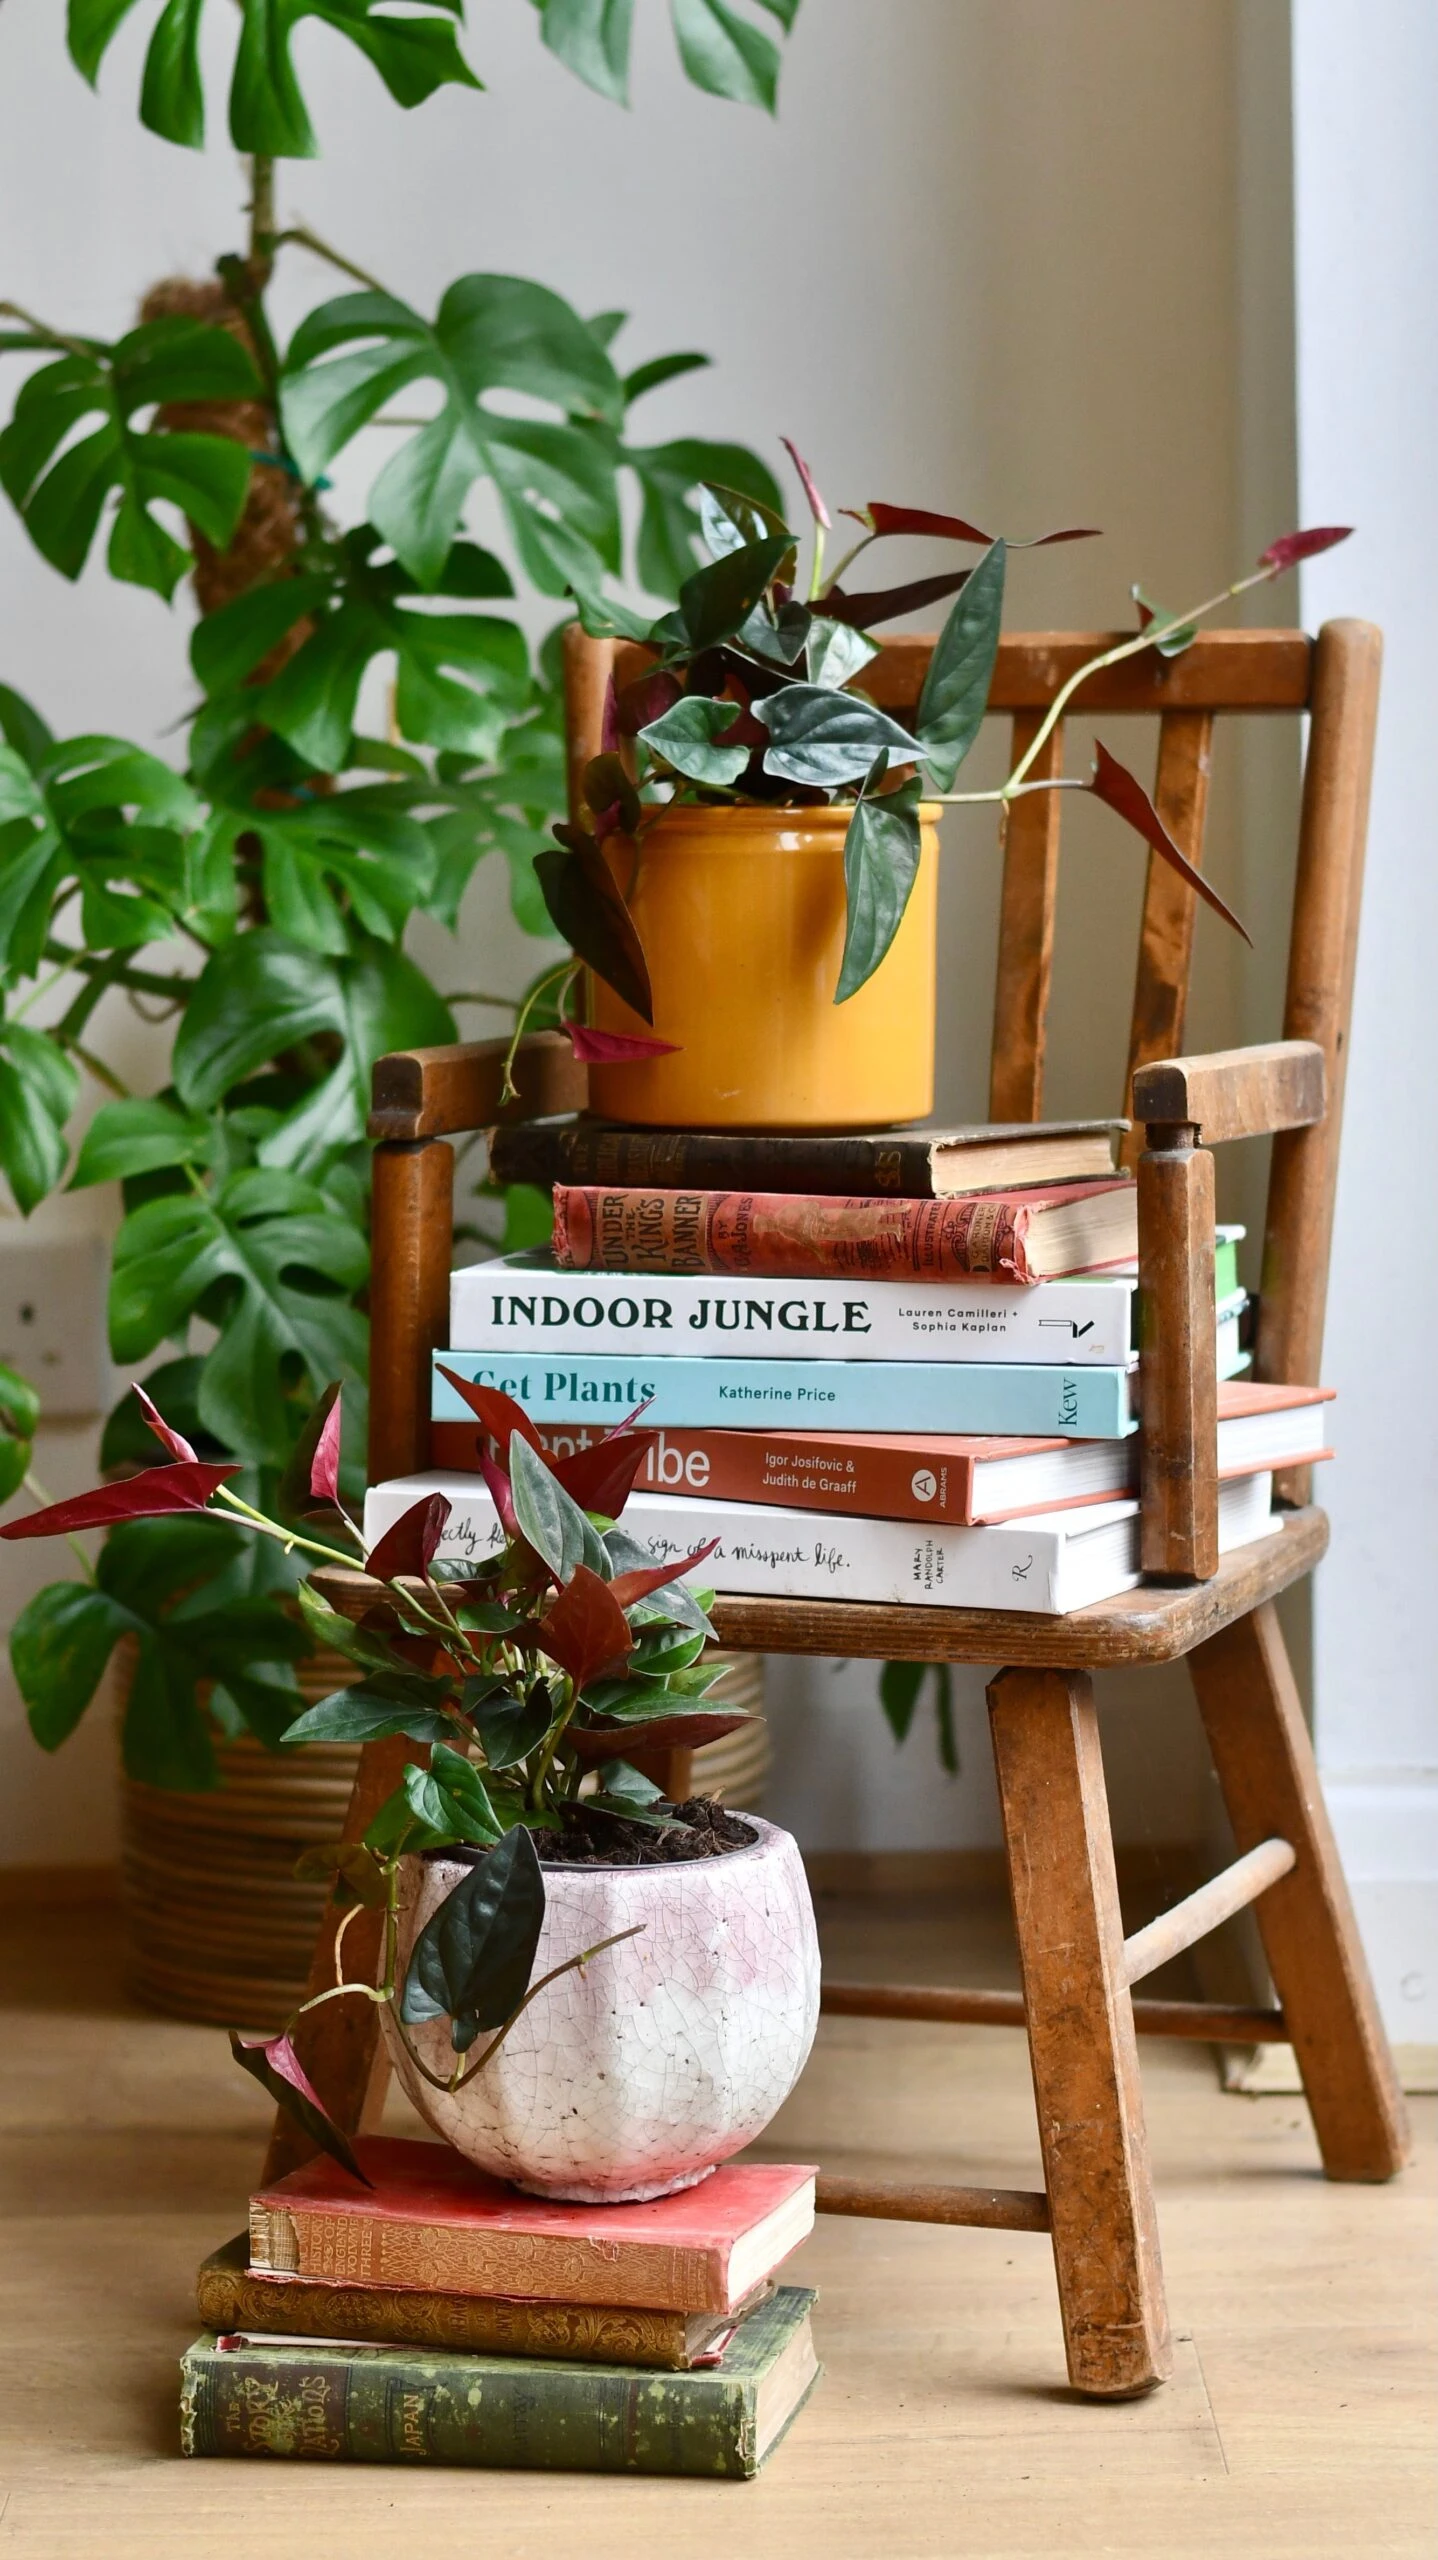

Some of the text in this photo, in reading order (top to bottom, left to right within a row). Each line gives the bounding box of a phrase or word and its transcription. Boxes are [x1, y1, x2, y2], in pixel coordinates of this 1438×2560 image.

[601, 1193, 629, 1268] UNDER
[625, 1207, 637, 1240] THE
[632, 1197, 669, 1262] KING'S
[672, 1194, 706, 1269] BANNER
[717, 1220, 728, 1240] BY
[491, 1296, 872, 1333] INDOOR JUNGLE
[898, 1308, 942, 1317] Lauren
[947, 1308, 1007, 1319] Camilleri
[912, 1321, 1006, 1333] Sophia Kaplan
[544, 1372, 656, 1403] Plants
[719, 1386, 836, 1401] Katherine Price
[1058, 1377, 1077, 1426] Kew
[765, 1452, 855, 1473] Igor Josifovic &
[762, 1472, 857, 1494] Judith de Graaff
[939, 1467, 947, 1508] ABRAMS
[647, 1534, 682, 1563] sign
[713, 1545, 726, 1559] a
[731, 1544, 809, 1568] misspent
[913, 1548, 923, 1581] MARY
[924, 1540, 934, 1590] RANDOLPH
[936, 1547, 945, 1584] CARTER
[310, 2216, 323, 2273] HISTORY
[324, 2216, 335, 2239] OF
[335, 2216, 348, 2275] ENGLAND
[361, 2230, 373, 2277] THREE
[401, 2394, 428, 2455] JAPAN
